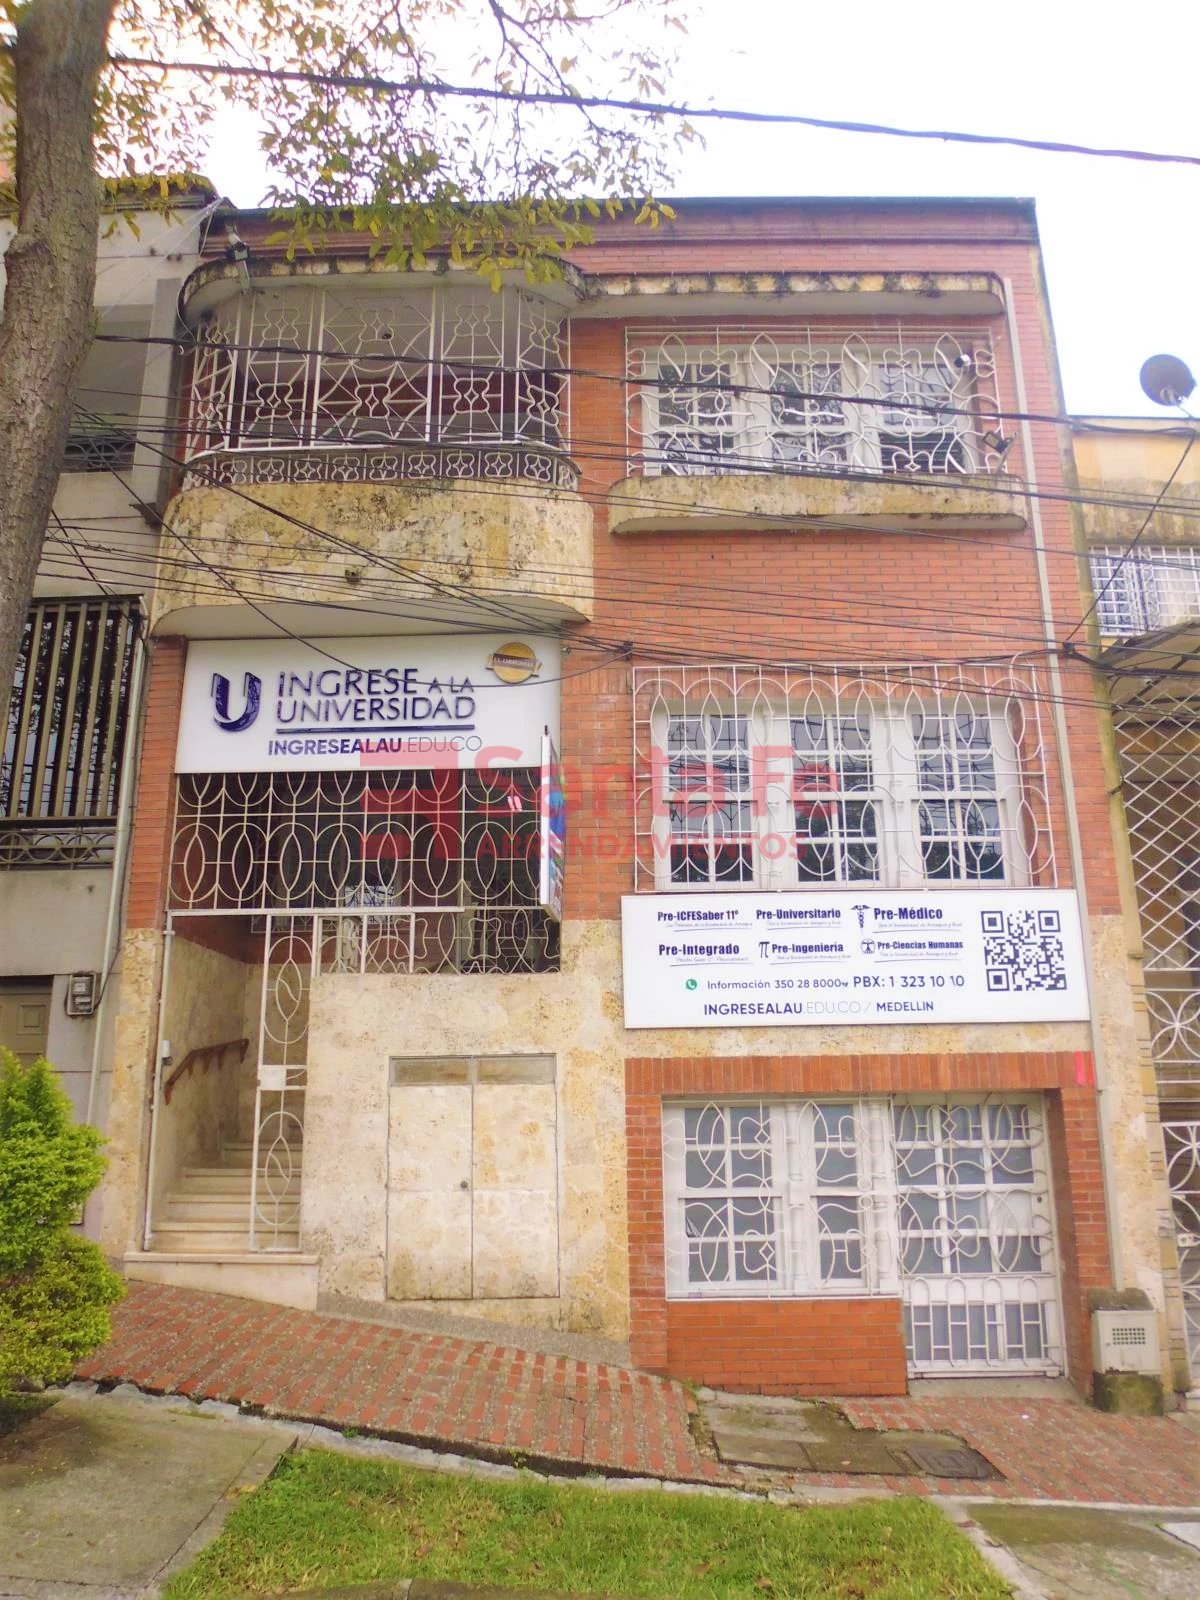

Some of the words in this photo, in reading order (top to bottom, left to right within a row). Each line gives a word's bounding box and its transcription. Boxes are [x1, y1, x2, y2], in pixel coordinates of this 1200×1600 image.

[278, 668, 418, 697] INGRESE
[428, 677, 443, 694] A
[450, 676, 475, 694] LA
[277, 696, 476, 723] UNIVERSIDAD
[268, 735, 482, 756] INGRESEALAU.EDU.CO
[756, 908, 841, 920] Pre-Universitario
[658, 943, 740, 957] Pre-Integrado
[877, 940, 926, 950] Pre-Ciencias
[928, 941, 963, 949] Humanas
[707, 979, 770, 990] Información
[774, 979, 793, 989] 350
[797, 979, 810, 989] 28
[853, 976, 885, 988] PBX:
[888, 976, 895, 987] 1
[901, 976, 925, 987] 323
[930, 975, 945, 987] 10
[950, 975, 965, 987] 10
[876, 1001, 934, 1012] MEDELLIN
